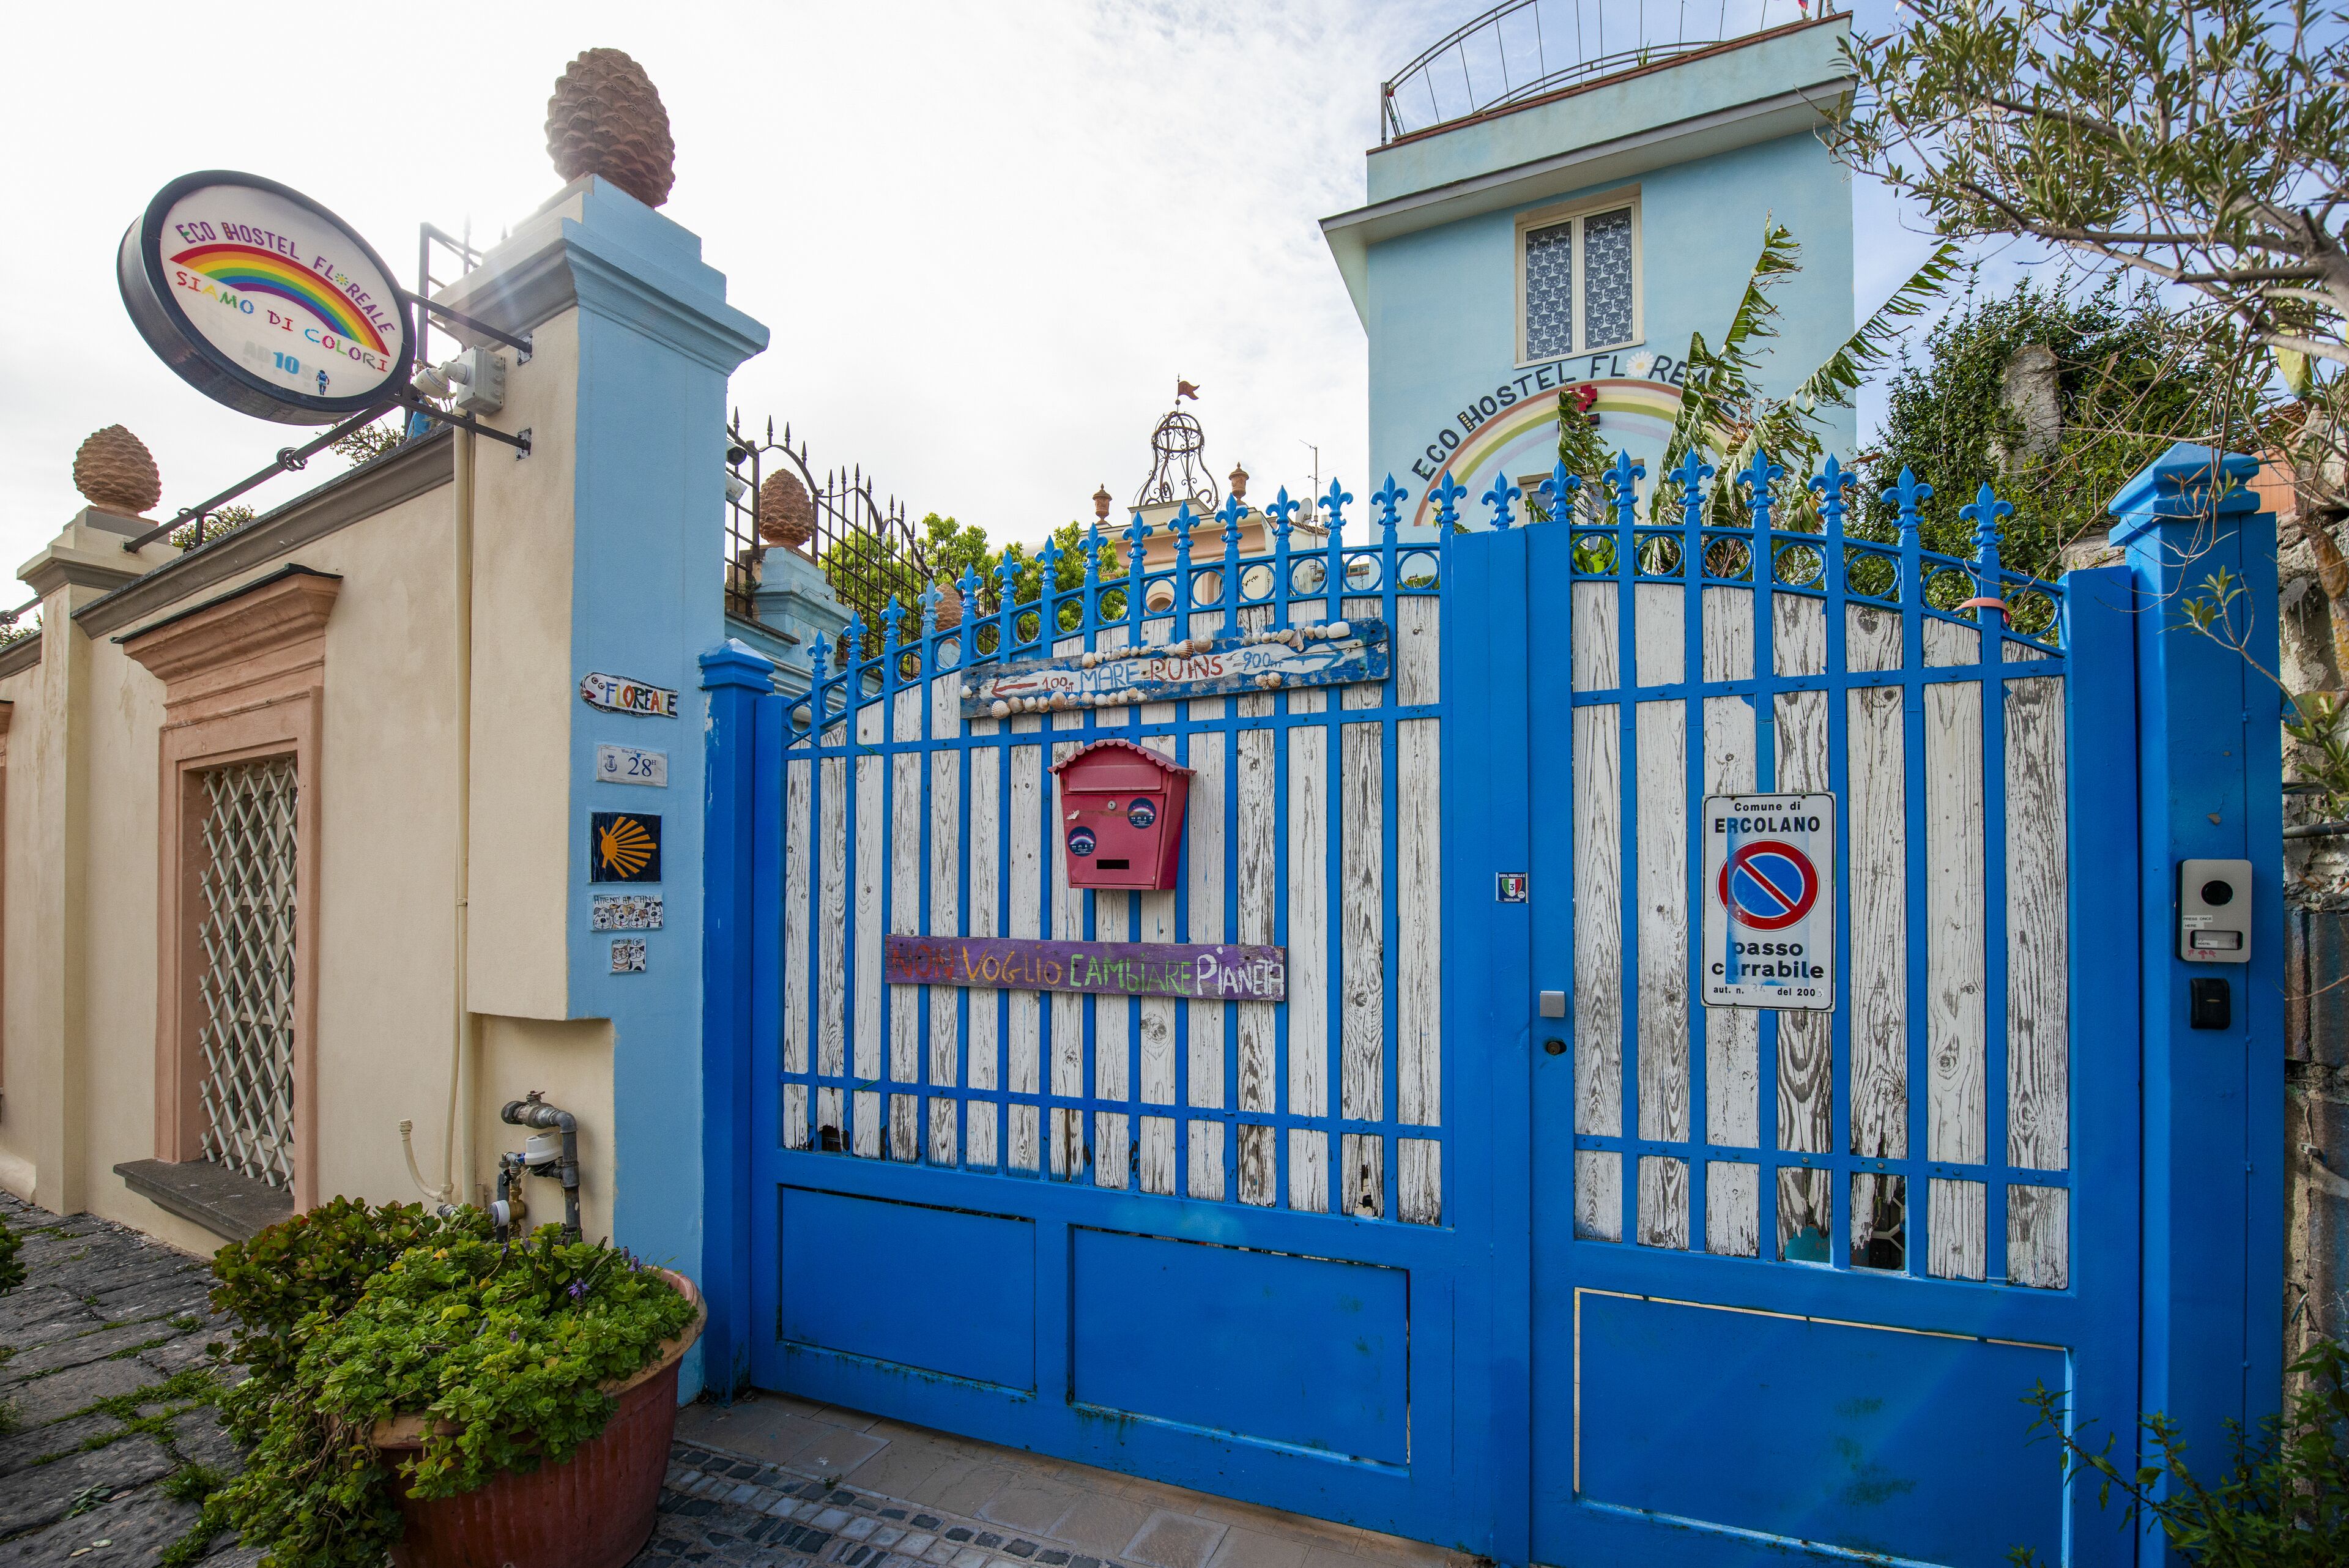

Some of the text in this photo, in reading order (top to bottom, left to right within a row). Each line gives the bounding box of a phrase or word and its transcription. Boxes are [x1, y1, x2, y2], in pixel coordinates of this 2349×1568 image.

[176, 221, 216, 243] ECO
[221, 222, 300, 260] HOSTEL
[177, 271, 254, 314] SIAMO
[267, 310, 294, 332] DI
[305, 329, 387, 373] COLORI
[1411, 429, 1460, 482] ECO
[1457, 362, 1576, 433] HOSTEL
[1080, 661, 1138, 692] MARE
[604, 681, 678, 717] FLOREALE
[1734, 801, 1801, 812] Comune di
[1715, 816, 1820, 834] ERCOLANO
[892, 943, 956, 979] NON
[1732, 942, 1803, 957] passo
[1712, 960, 1824, 979] crrabile
[1777, 987, 1792, 996] del
